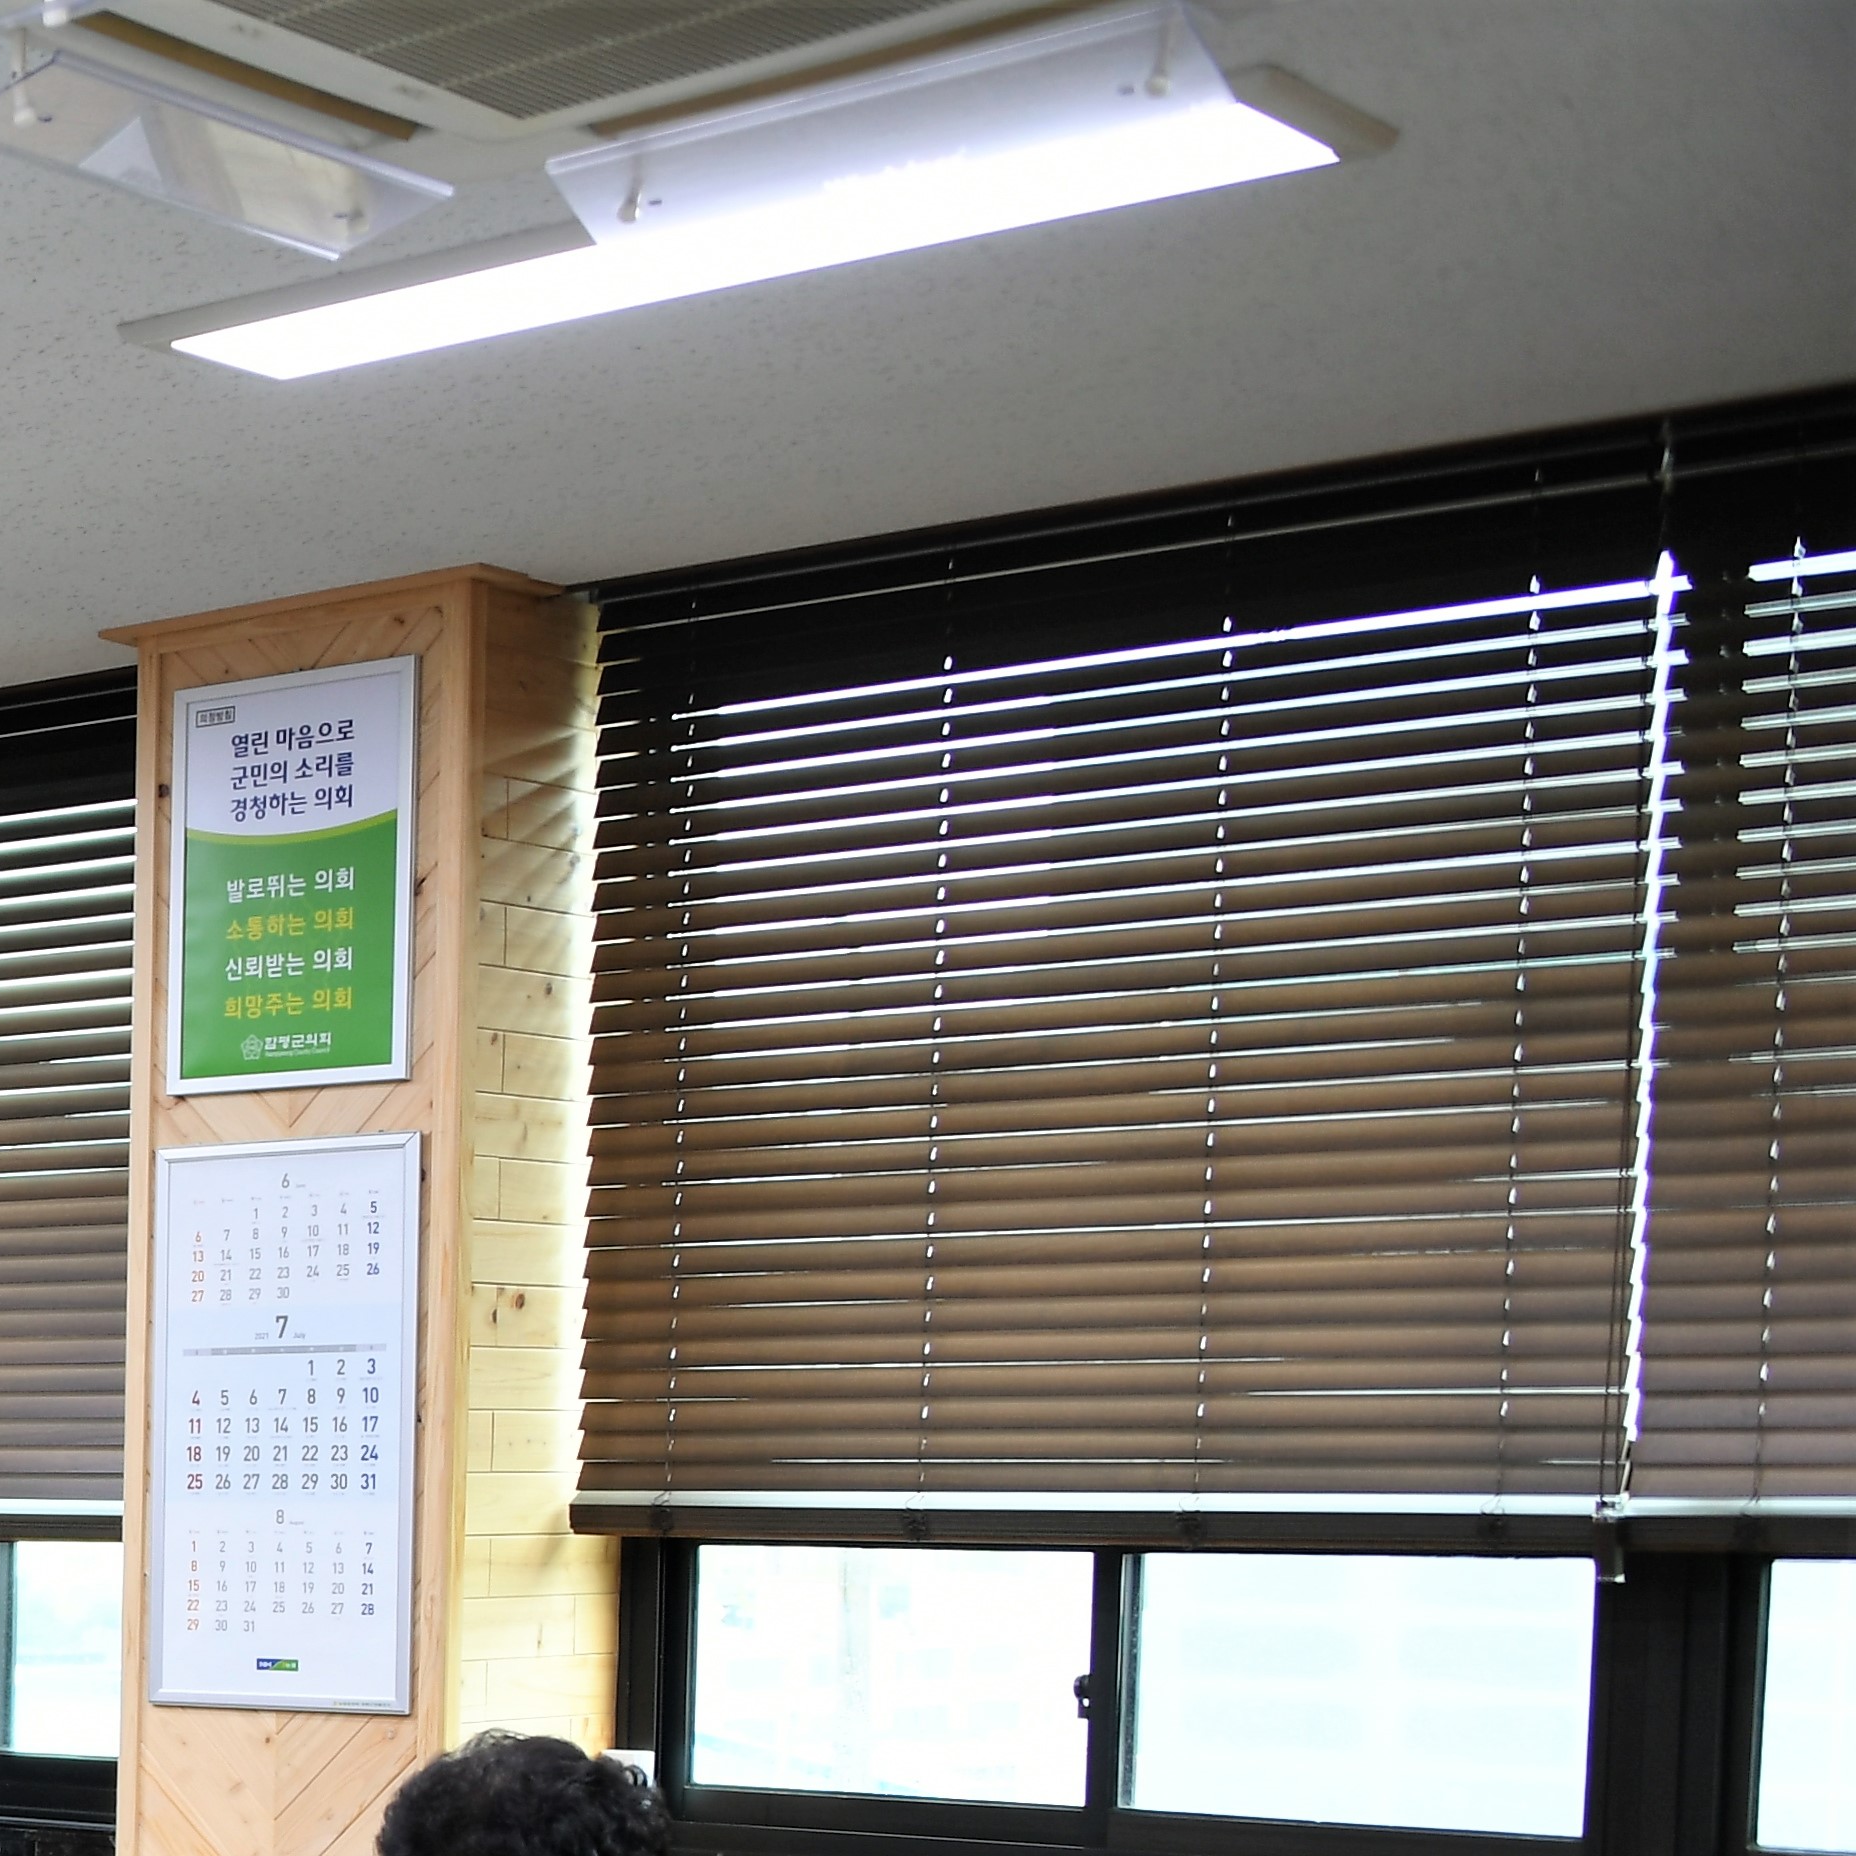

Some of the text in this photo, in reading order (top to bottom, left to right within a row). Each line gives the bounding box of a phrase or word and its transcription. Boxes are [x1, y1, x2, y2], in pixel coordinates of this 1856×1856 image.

[231, 719, 355, 758] 열린 마음으로
[230, 751, 354, 790] 군민의 소리를
[230, 784, 353, 822] 경청하는 의회
[226, 866, 354, 904] 발로뛰는 의회
[226, 906, 353, 941] 소통하는 의회
[225, 946, 353, 981] 신뢰받는 의회
[224, 986, 352, 1019] 희망주는 의회
[281, 1172, 290, 1189] 6
[281, 1205, 289, 1219] 2
[311, 1204, 318, 1217] 3
[340, 1203, 347, 1215] 4
[370, 1200, 378, 1214] 5
[195, 1221, 380, 1243] 6 7 8 9 10 11 12
[192, 1241, 380, 1263] 13 14 15 16 17 18 19
[191, 1262, 380, 1283] 20 21 22 23 24 25 26
[191, 1286, 290, 1303] 27 28 29 30
[275, 1315, 289, 1339] 7
[307, 1357, 376, 1376] 1 2 3
[191, 1386, 379, 1406] 4 5 6 7 8 9 10
[188, 1415, 379, 1434] 11 12 13 14 15 16 17
[186, 1444, 379, 1462] 18 19 20 21 22 23 24
[187, 1473, 376, 1490] 25 26 27 28 29 30 31
[275, 1508, 285, 1525] 8
[219, 1540, 226, 1553] 2
[247, 1540, 255, 1554] 3
[276, 1542, 283, 1553] 4
[305, 1541, 313, 1554] 5
[335, 1542, 342, 1555] 6
[365, 1542, 373, 1555] 7
[191, 1560, 374, 1575] 8 9 10 11 12 13 14
[188, 1579, 374, 1596] 15 16 17 18 19 20 21
[187, 1598, 375, 1616] 22 23 24 25 26 27 28
[186, 1618, 255, 1633] 29 30 31
